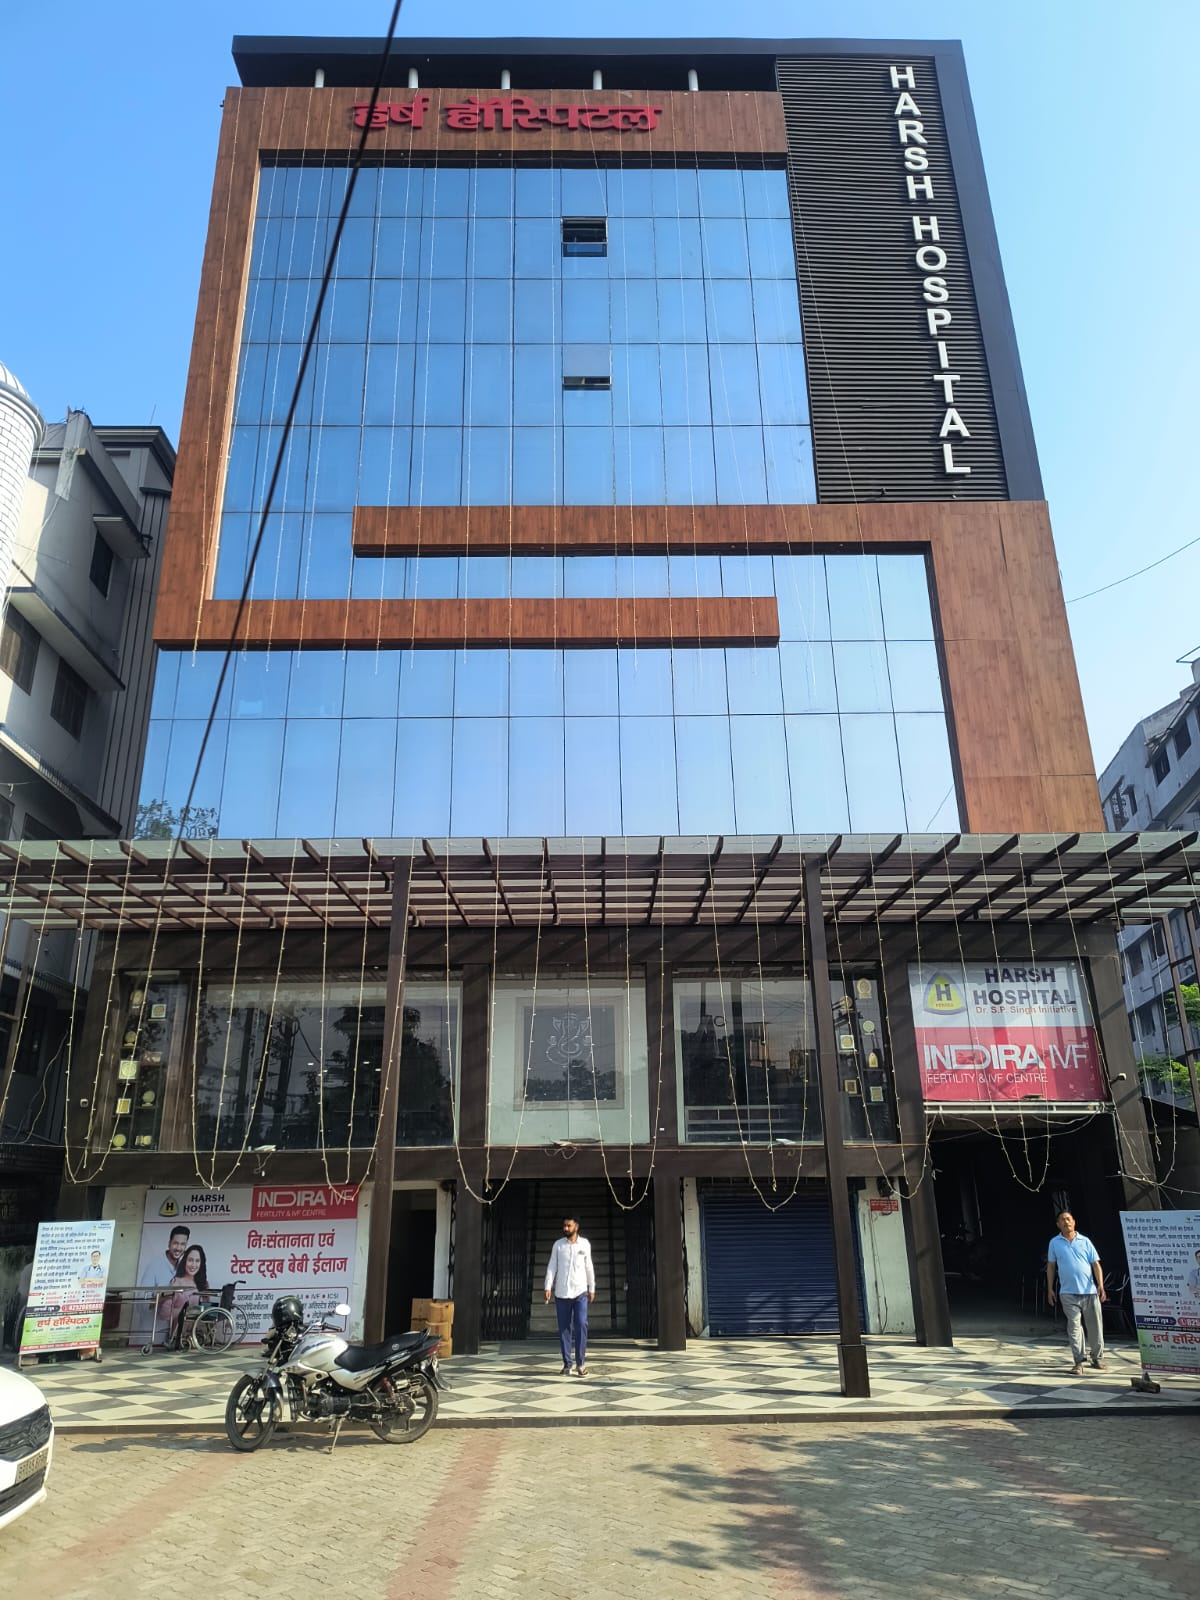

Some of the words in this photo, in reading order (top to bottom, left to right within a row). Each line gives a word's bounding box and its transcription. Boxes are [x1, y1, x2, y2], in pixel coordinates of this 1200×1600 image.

[352, 95, 429, 130] हर्ष
[889, 65, 935, 200] HARSH
[912, 215, 972, 474] HOSPITAL
[984, 967, 1057, 983] HARSH
[972, 989, 1077, 1006] HOSPITAL
[1038, 1005, 1078, 1014] Initiative
[923, 1043, 1047, 1070] INDIRA
[1048, 1043, 1090, 1070] IVF
[926, 1072, 976, 1084] FERTILITY
[978, 1073, 986, 1084] &
[987, 1073, 1003, 1084] IVF
[1006, 1072, 1049, 1084] CENTRE
[190, 1194, 226, 1203] HARSH
[257, 1190, 327, 1208] INDIRA
[329, 1188, 354, 1206] IVF
[183, 1204, 232, 1213] HOSPITAL
[256, 1210, 285, 1218] FERTILITY
[247, 1229, 315, 1249] निःसंतानता
[318, 1228, 336, 1247] एवं
[230, 1254, 255, 1275] टेस्ट
[287, 1252, 310, 1274] बेबी
[312, 1251, 349, 1276] ईलाज
